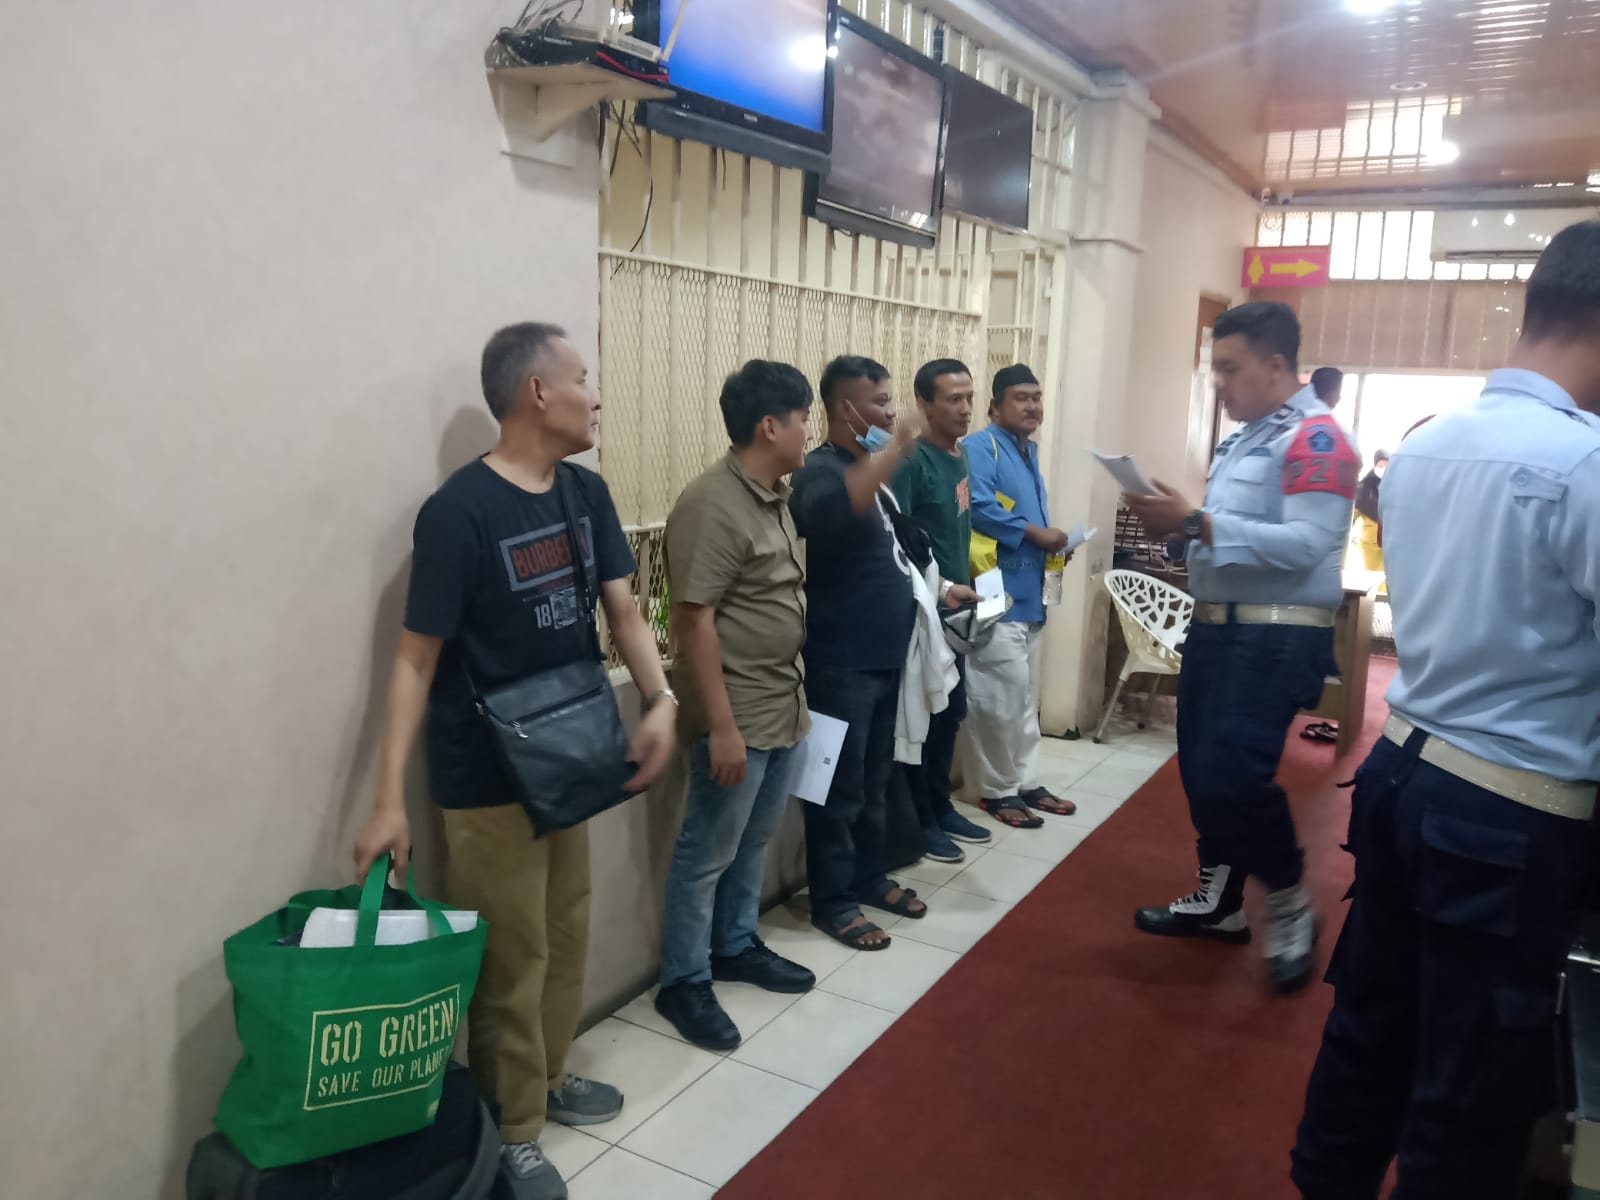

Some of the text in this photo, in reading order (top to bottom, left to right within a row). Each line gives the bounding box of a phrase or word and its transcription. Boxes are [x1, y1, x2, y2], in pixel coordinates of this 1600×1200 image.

[320, 997, 454, 1066] GO GREEN
[317, 1070, 361, 1098] SAVE
[371, 1063, 405, 1088] OUR
